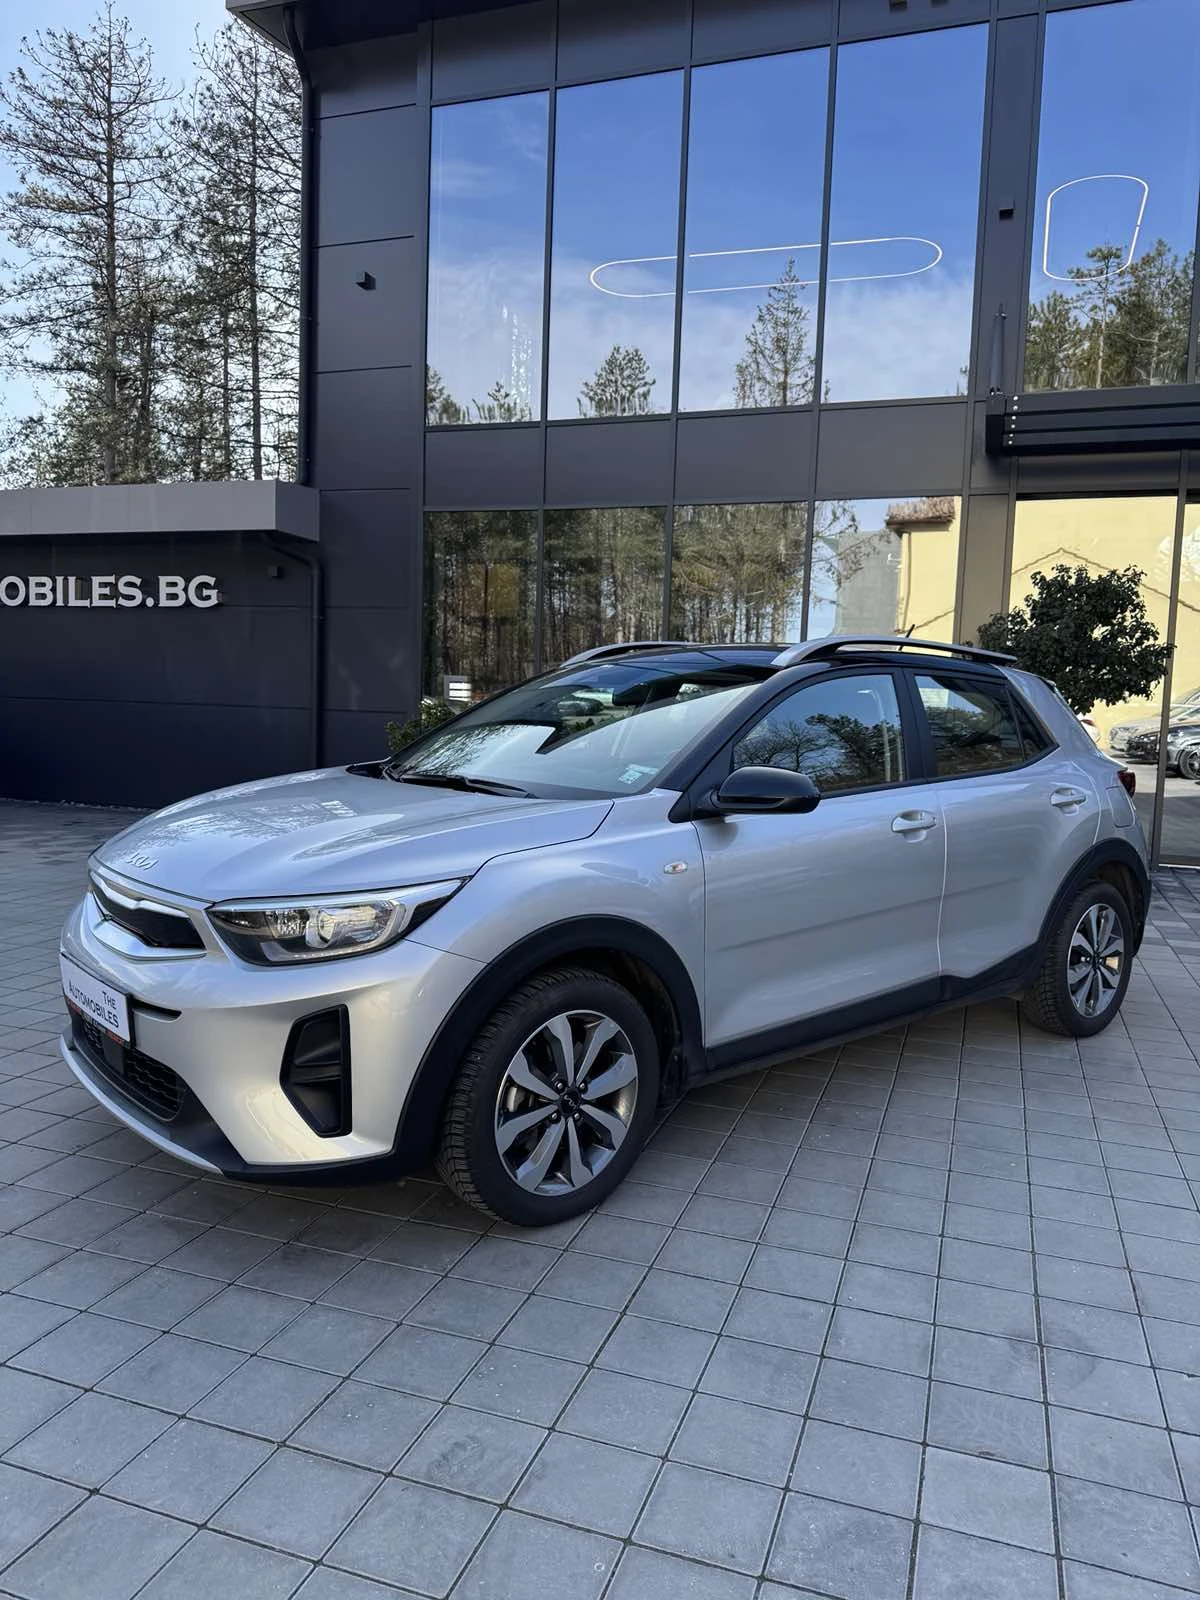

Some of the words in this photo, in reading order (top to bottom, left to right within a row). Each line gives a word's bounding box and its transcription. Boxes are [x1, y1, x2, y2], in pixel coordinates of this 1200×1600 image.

[0, 574, 219, 608] OBILES.BG
[68, 979, 119, 1028] AUTOMOBILES
[101, 990, 117, 1010] THE
